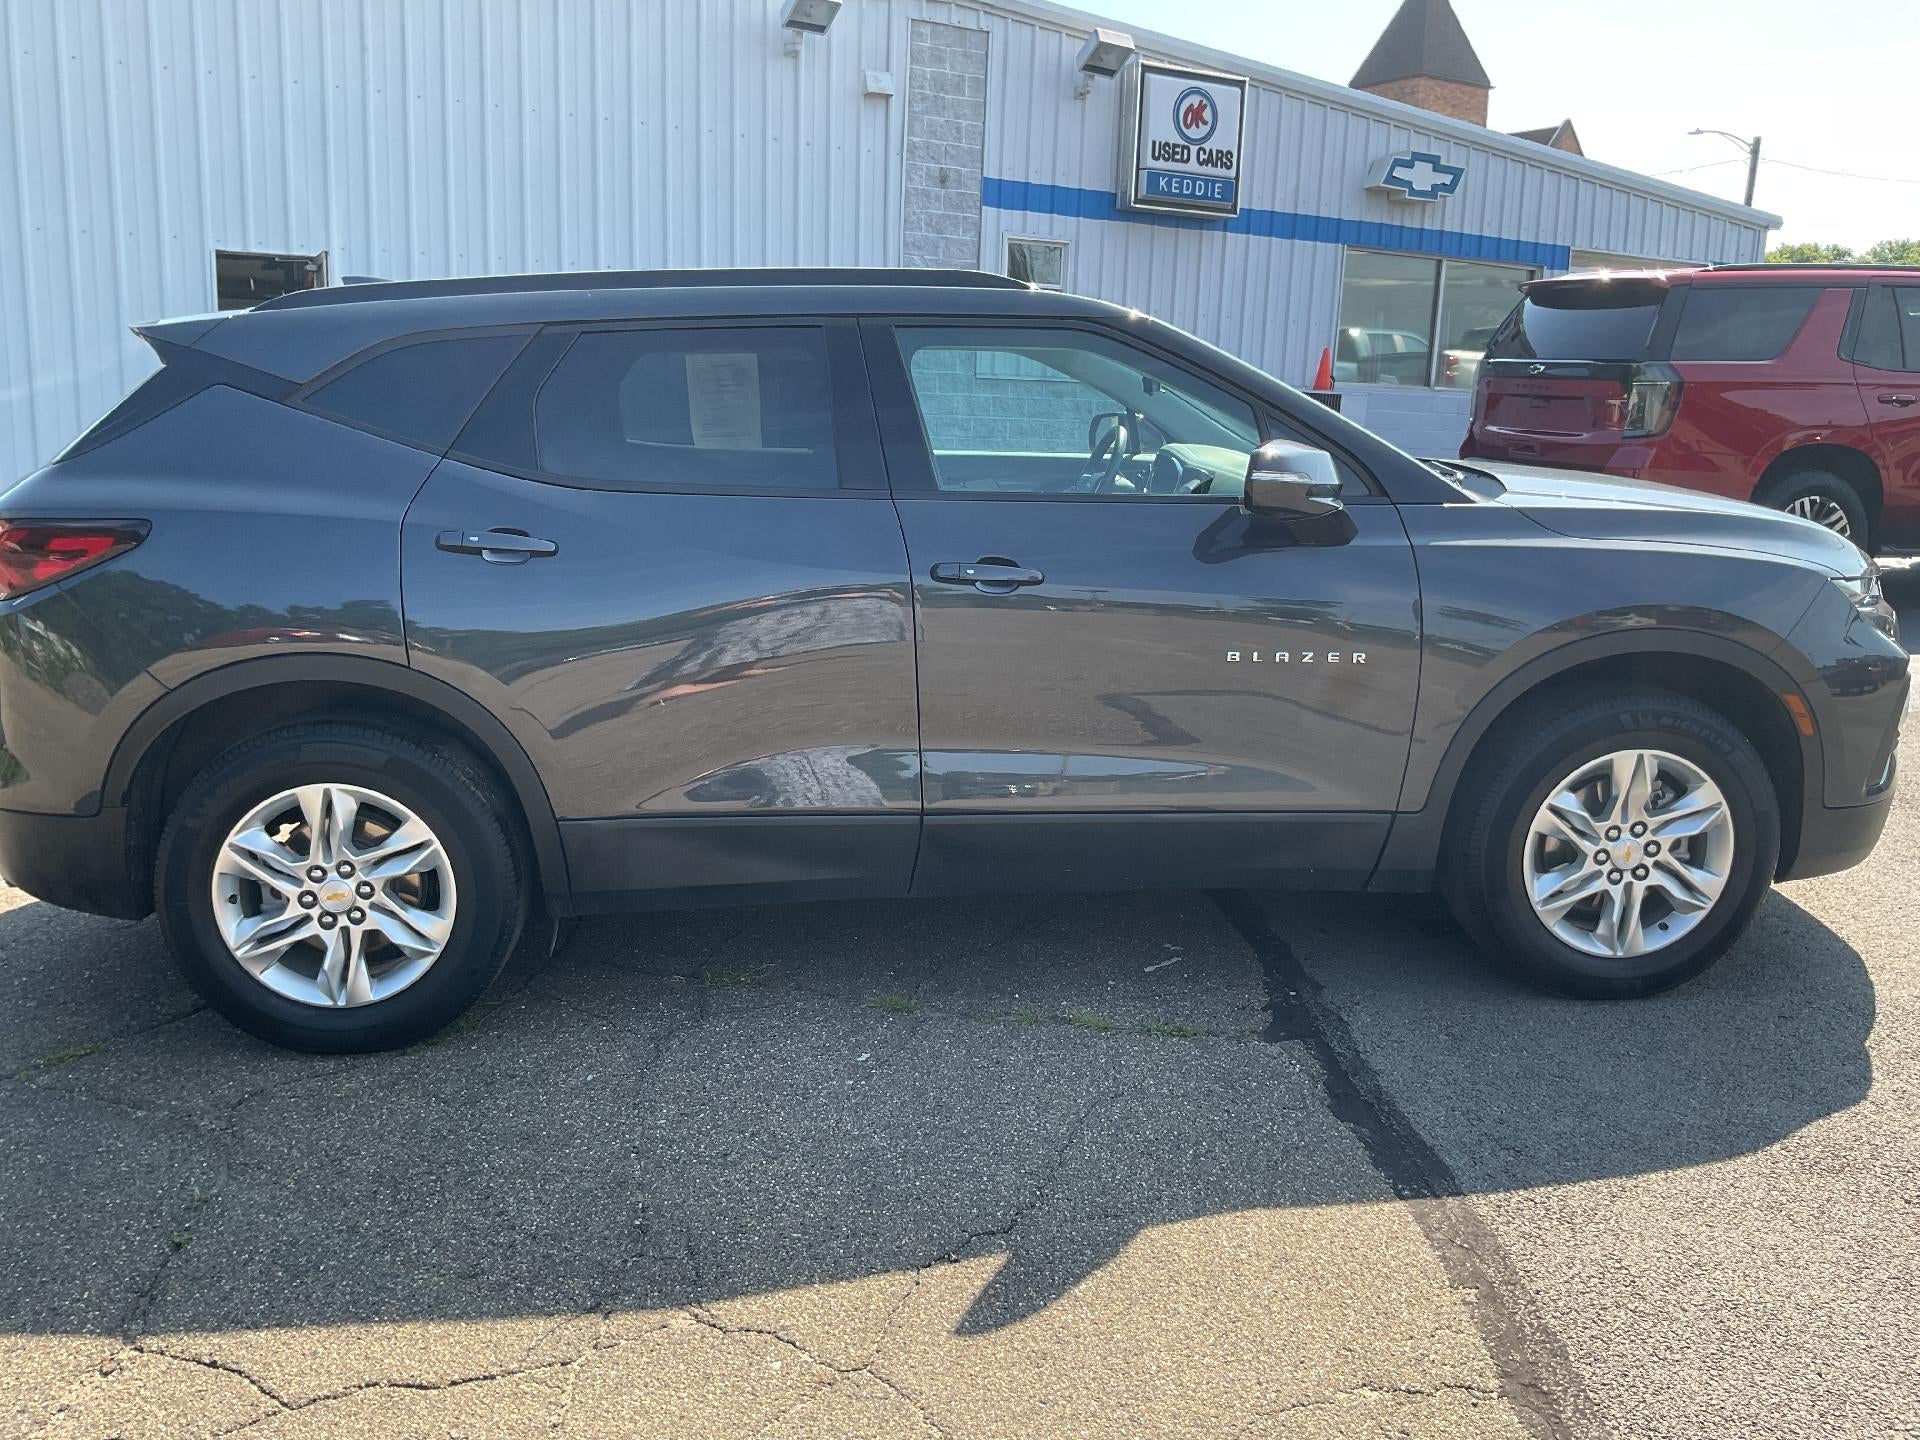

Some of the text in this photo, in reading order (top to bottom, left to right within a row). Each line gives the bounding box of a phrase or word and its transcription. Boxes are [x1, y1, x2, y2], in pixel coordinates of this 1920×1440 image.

[1183, 100, 1208, 129] OK
[1152, 140, 1233, 169] USED CARS
[1159, 176, 1222, 198] KEDDIE
[1226, 651, 1366, 664] BLAZER
